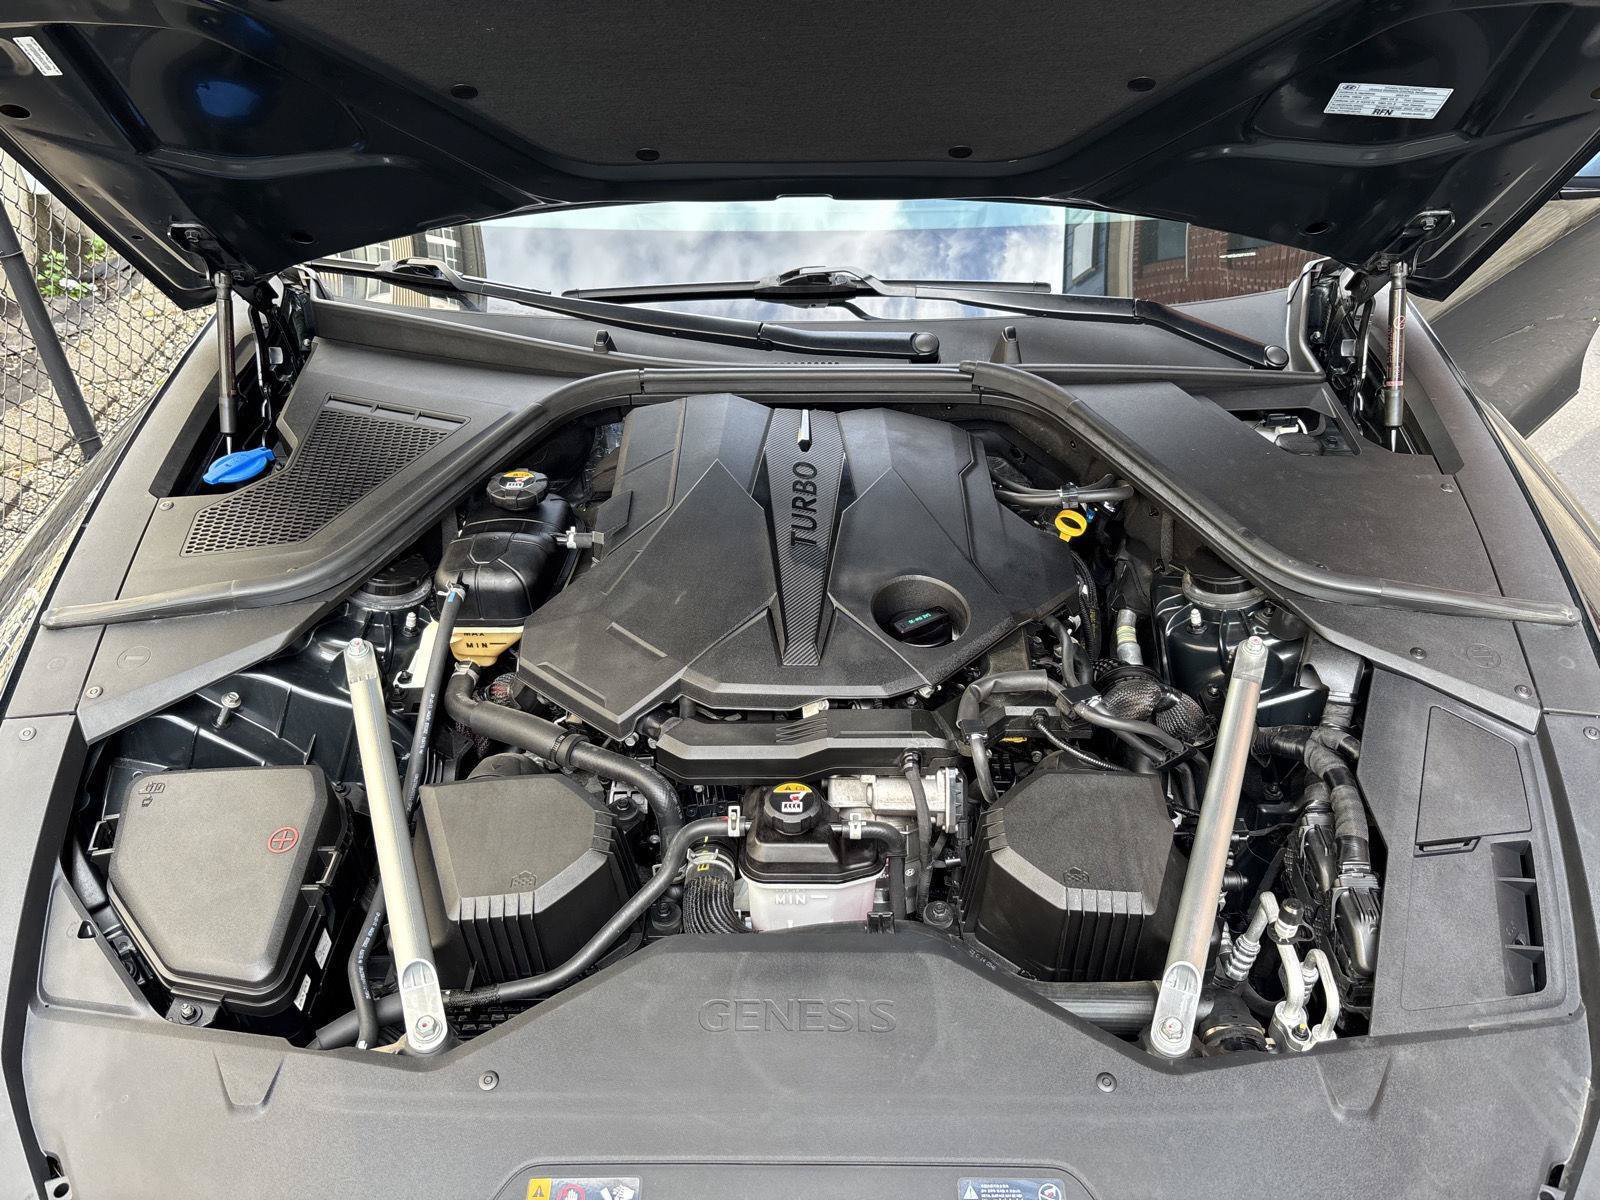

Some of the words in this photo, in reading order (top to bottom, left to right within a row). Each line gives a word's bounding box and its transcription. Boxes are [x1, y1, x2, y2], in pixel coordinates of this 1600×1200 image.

[1372, 108, 1394, 116] RFN
[791, 461, 818, 547] TURBO
[775, 893, 807, 905] MIN
[698, 998, 897, 1033] GENESIS
